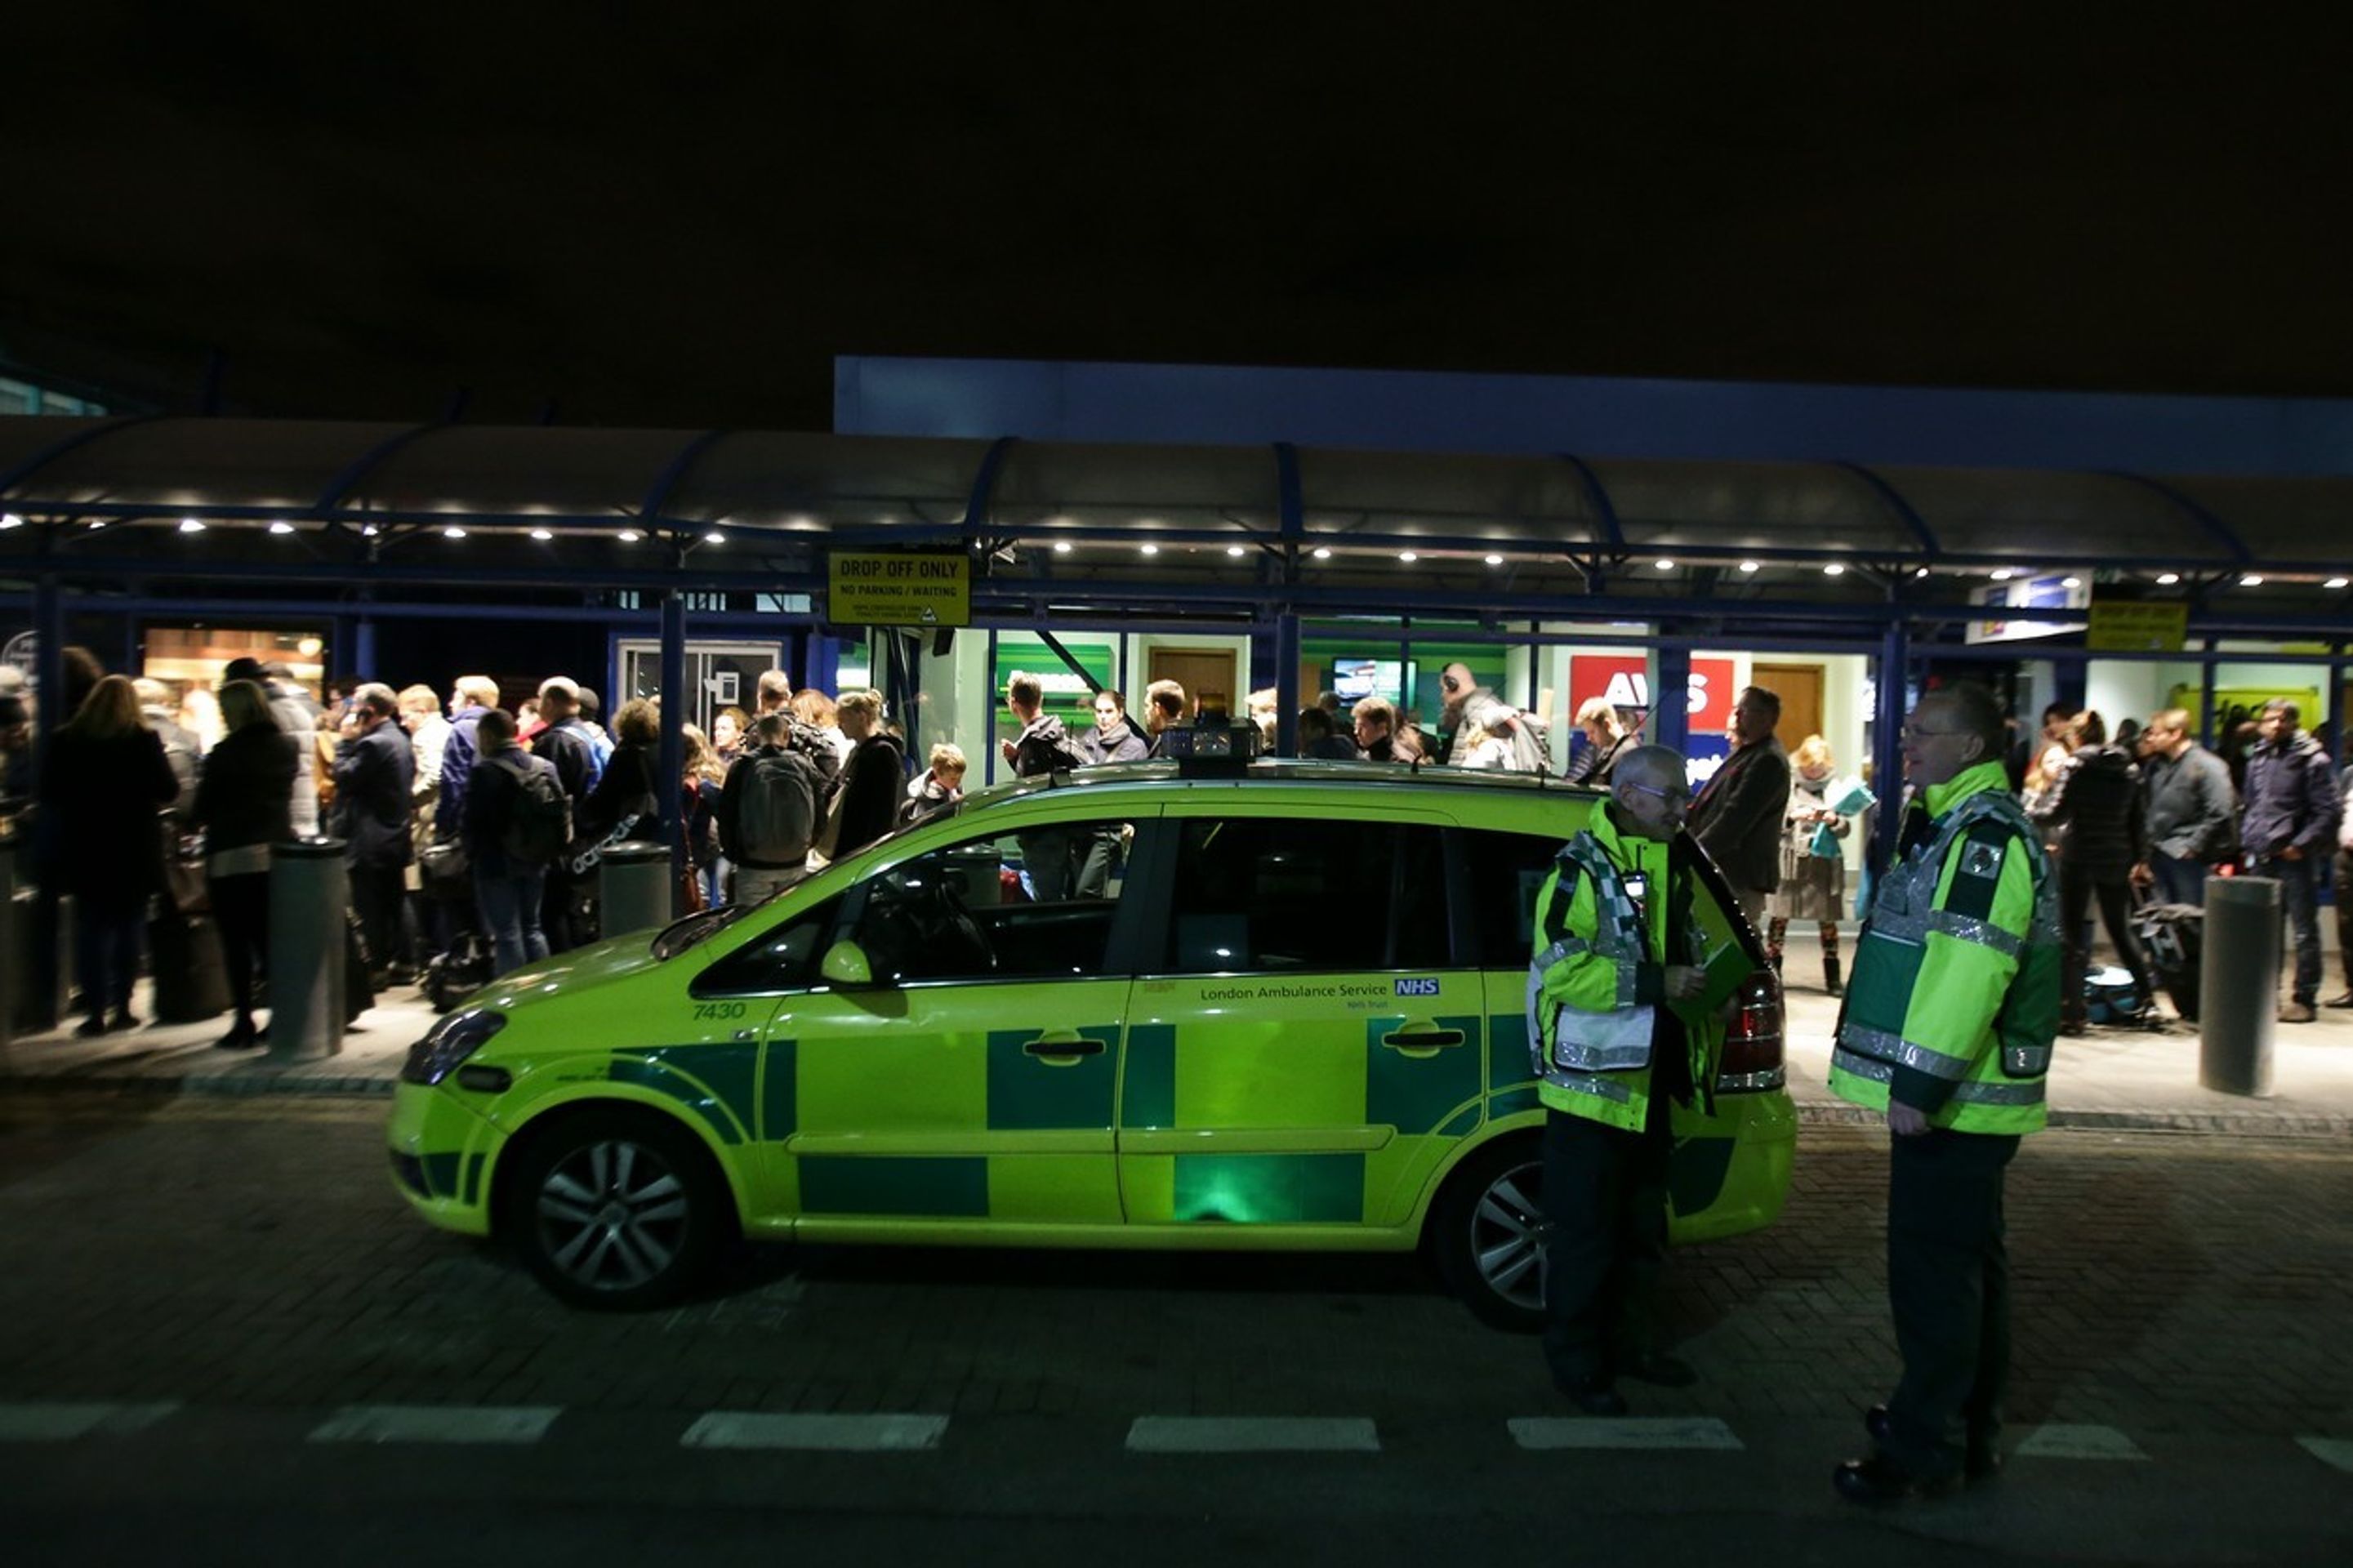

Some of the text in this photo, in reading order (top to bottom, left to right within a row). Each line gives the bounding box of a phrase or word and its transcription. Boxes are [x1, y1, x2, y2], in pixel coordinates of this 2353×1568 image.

[841, 560, 958, 577] DROP OFF ONLY
[840, 586, 855, 595] NO
[859, 586, 902, 596] PARKING
[913, 587, 956, 597] WAITING
[1201, 980, 1437, 1000] London Ambulance Service NHS
[693, 1002, 746, 1020] 7430
